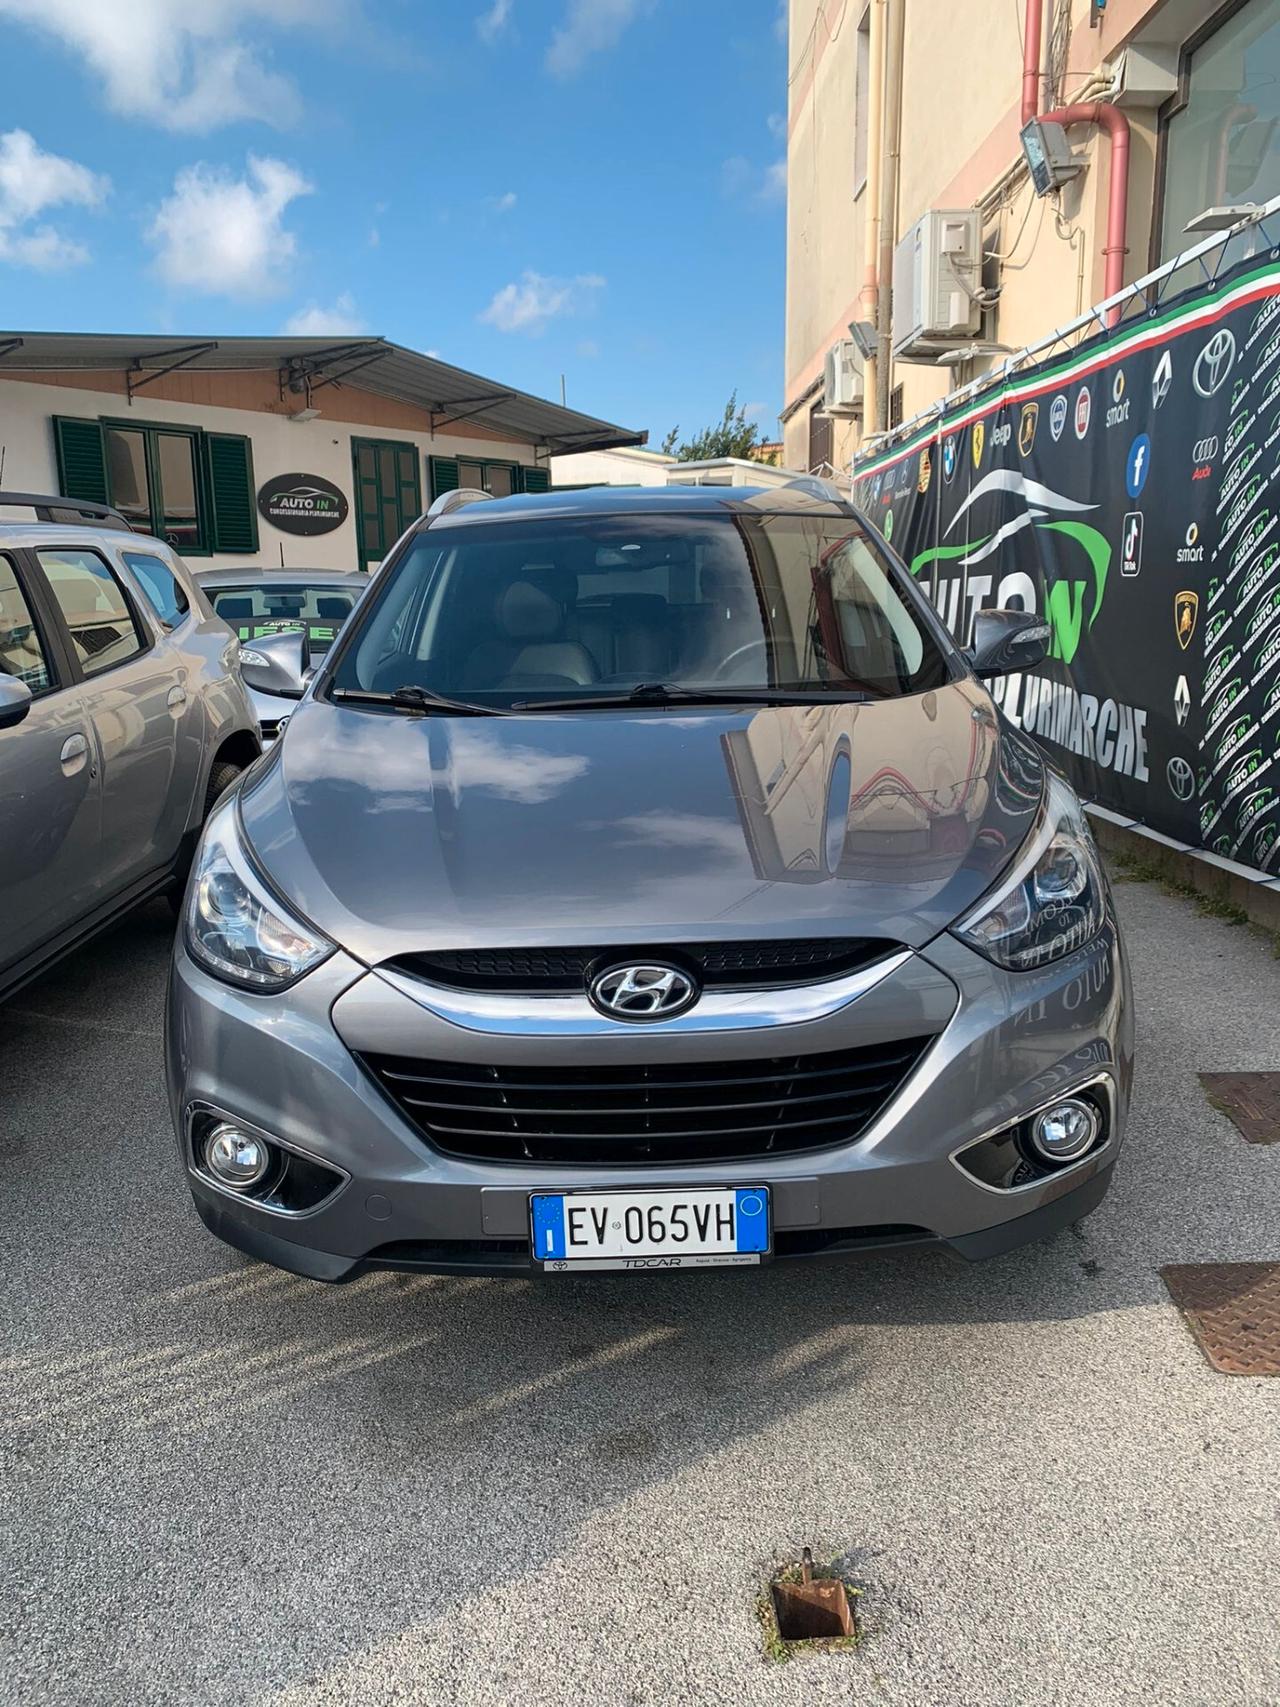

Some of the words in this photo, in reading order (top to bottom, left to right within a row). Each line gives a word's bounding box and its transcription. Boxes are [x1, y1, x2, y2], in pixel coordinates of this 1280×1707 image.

[1106, 398, 1131, 428] smart
[1220, 468, 1241, 500] AUTO
[280, 498, 314, 509] AUTO
[317, 500, 329, 510] IN
[1227, 498, 1247, 531] AUTO
[1177, 545, 1204, 562] smart
[1235, 533, 1255, 565] AUTO
[1242, 567, 1264, 598] AUTO
[1251, 602, 1273, 634] AUTO
[1260, 637, 1280, 668] AUTO
[1205, 665, 1221, 692] AUTO
[1211, 697, 1229, 724] AUTO
[1219, 733, 1238, 760] AUTO
[1237, 723, 1246, 739] IN
[1227, 769, 1248, 793] AUTO
[1248, 758, 1258, 774] IN
[567, 1206, 608, 1246] EV
[624, 1202, 735, 1245] 065VH
[622, 1258, 682, 1268] TDCAR
